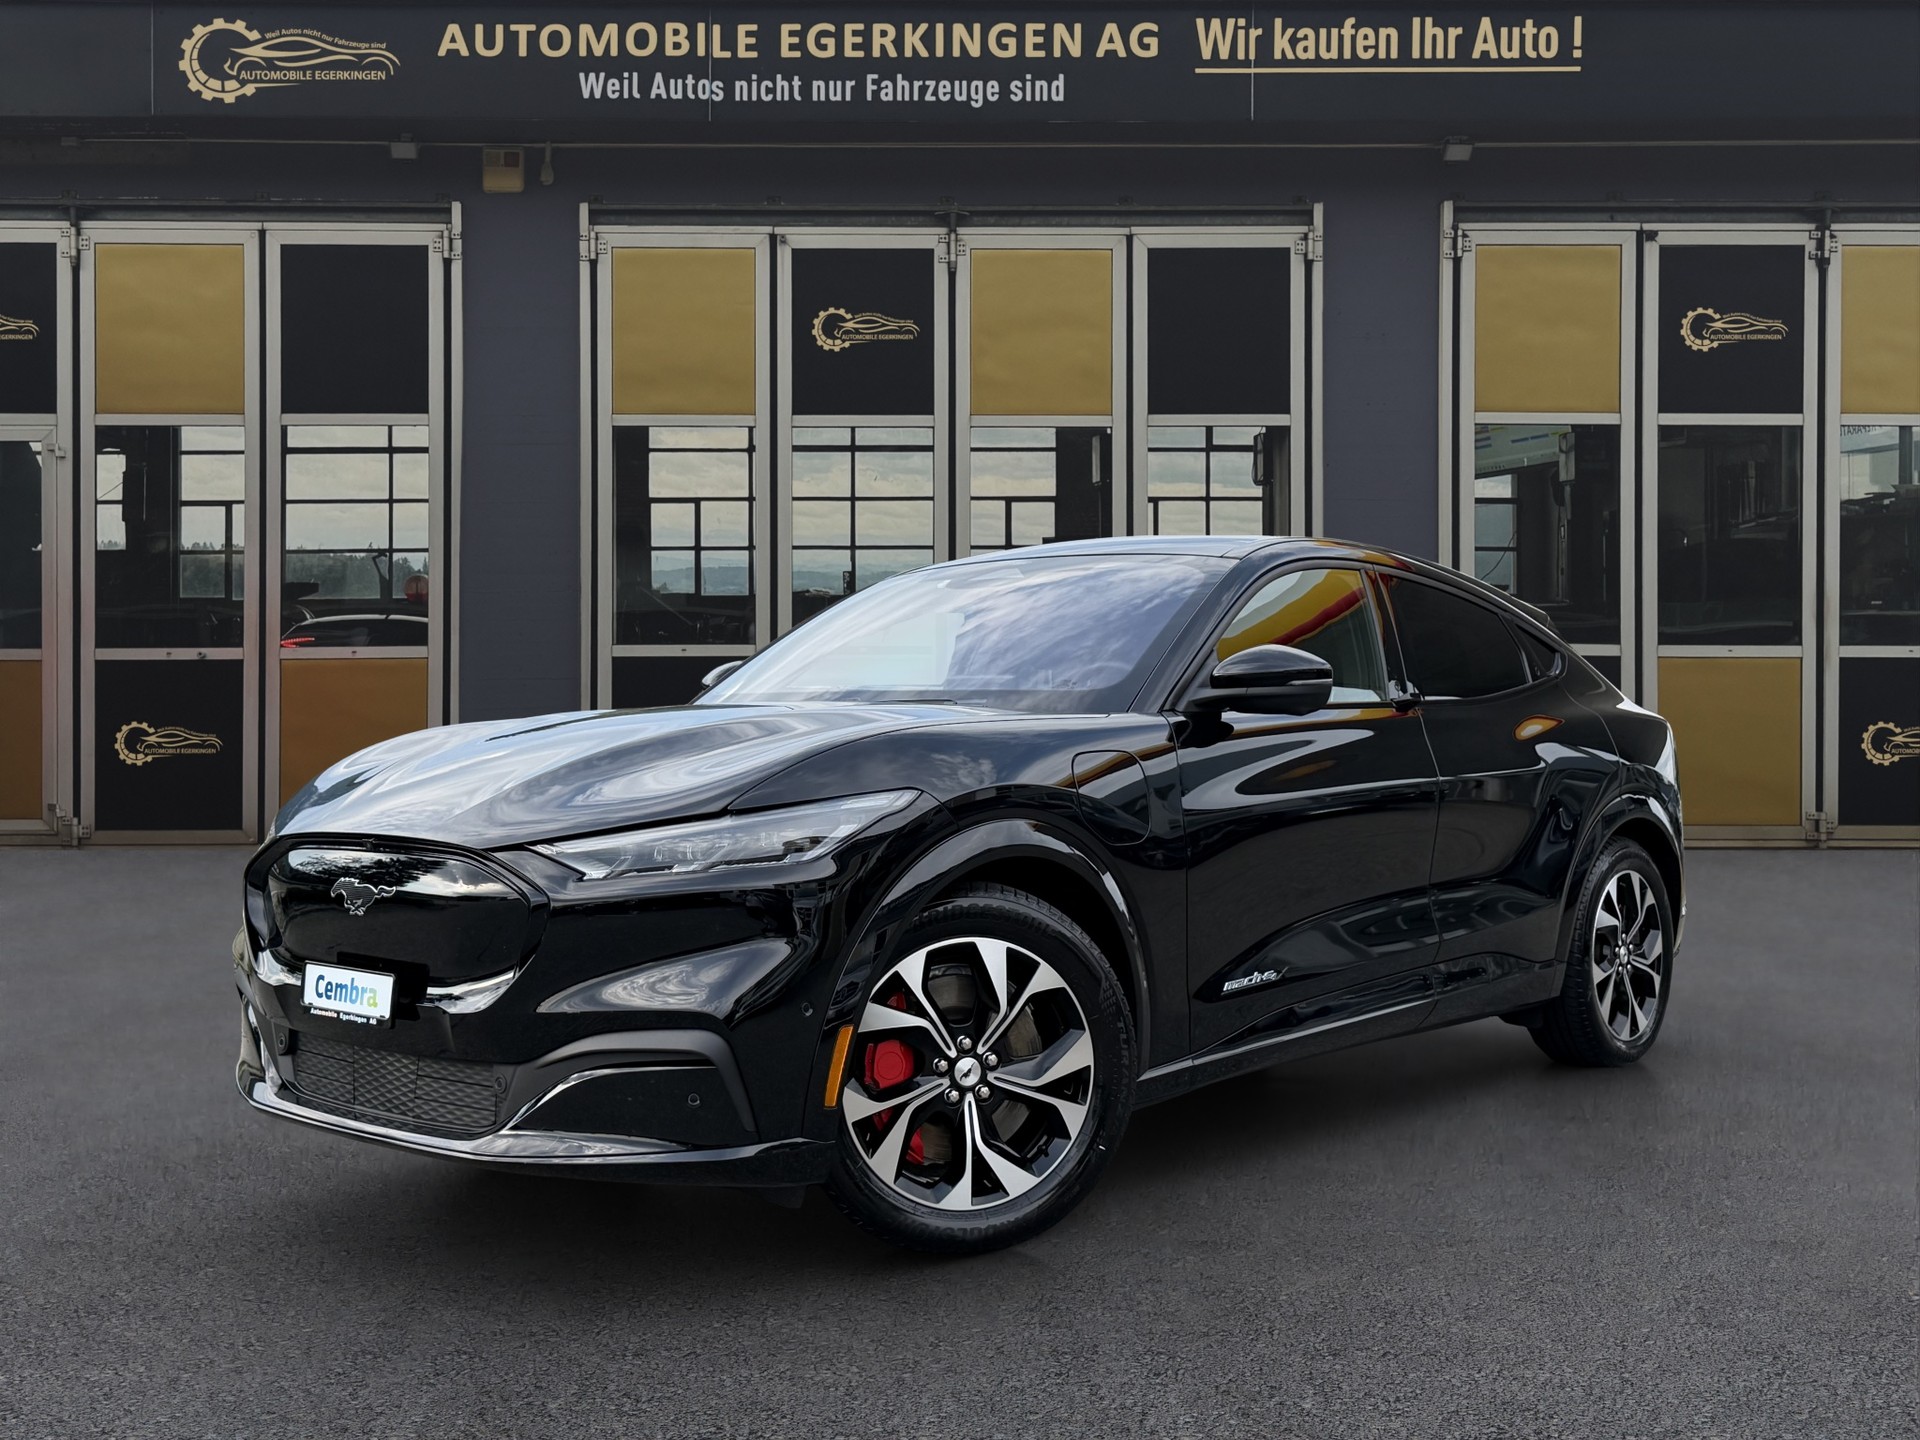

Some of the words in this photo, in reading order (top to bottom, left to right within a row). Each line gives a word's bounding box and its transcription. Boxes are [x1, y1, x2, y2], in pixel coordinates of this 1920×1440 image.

[264, 29, 281, 40] Weil
[281, 28, 302, 36] Autos
[303, 28, 322, 38] nicht
[321, 33, 334, 43] nur
[333, 37, 370, 49] Fahrzeuge
[370, 42, 387, 50] sind
[437, 22, 759, 58] AUTOMOBILE
[780, 22, 1082, 59] EGERKINGEN
[1096, 22, 1160, 59] AG
[1195, 17, 1262, 60] Wir
[1273, 16, 1399, 60] kaufen
[1411, 16, 1463, 60] Ihr
[1471, 16, 1560, 60] Auto
[239, 70, 312, 80] AUTOMOBILE
[314, 70, 386, 80] EGERKINGEN
[578, 71, 641, 100] Weil
[650, 72, 725, 102] Autos
[734, 73, 802, 102] nicht
[812, 79, 856, 102] nur
[866, 73, 1000, 108] Fahrzeuge
[1009, 73, 1065, 102] sind
[315, 974, 378, 1008] Cembra
[310, 1008, 337, 1017] Automobile
[340, 1012, 367, 1023] Egerkingen
